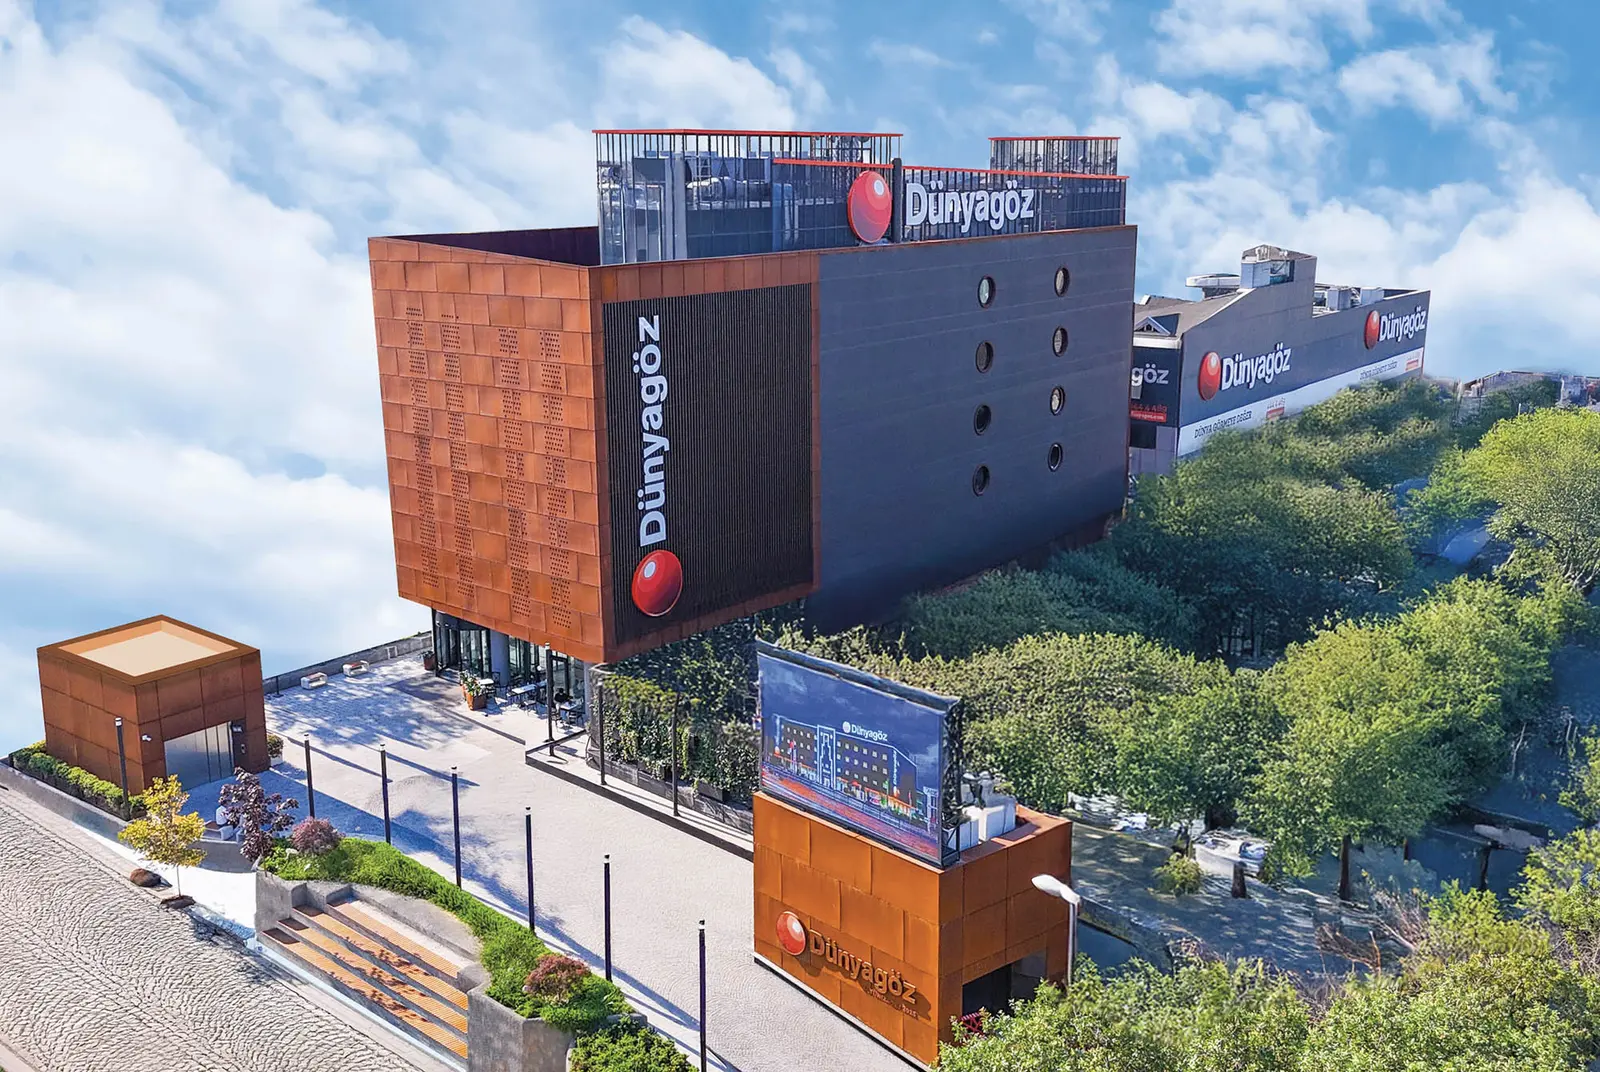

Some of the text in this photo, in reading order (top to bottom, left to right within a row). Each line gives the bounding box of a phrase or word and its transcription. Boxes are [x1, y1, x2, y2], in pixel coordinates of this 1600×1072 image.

[905, 180, 1035, 233] Dünyagöz
[1379, 306, 1427, 342] Dünyagöz
[1221, 342, 1292, 391] Dünyagöz
[633, 315, 670, 547] Dünyagöz
[851, 724, 888, 742] Dünyagöz
[809, 929, 917, 1005] Dünyagöz
